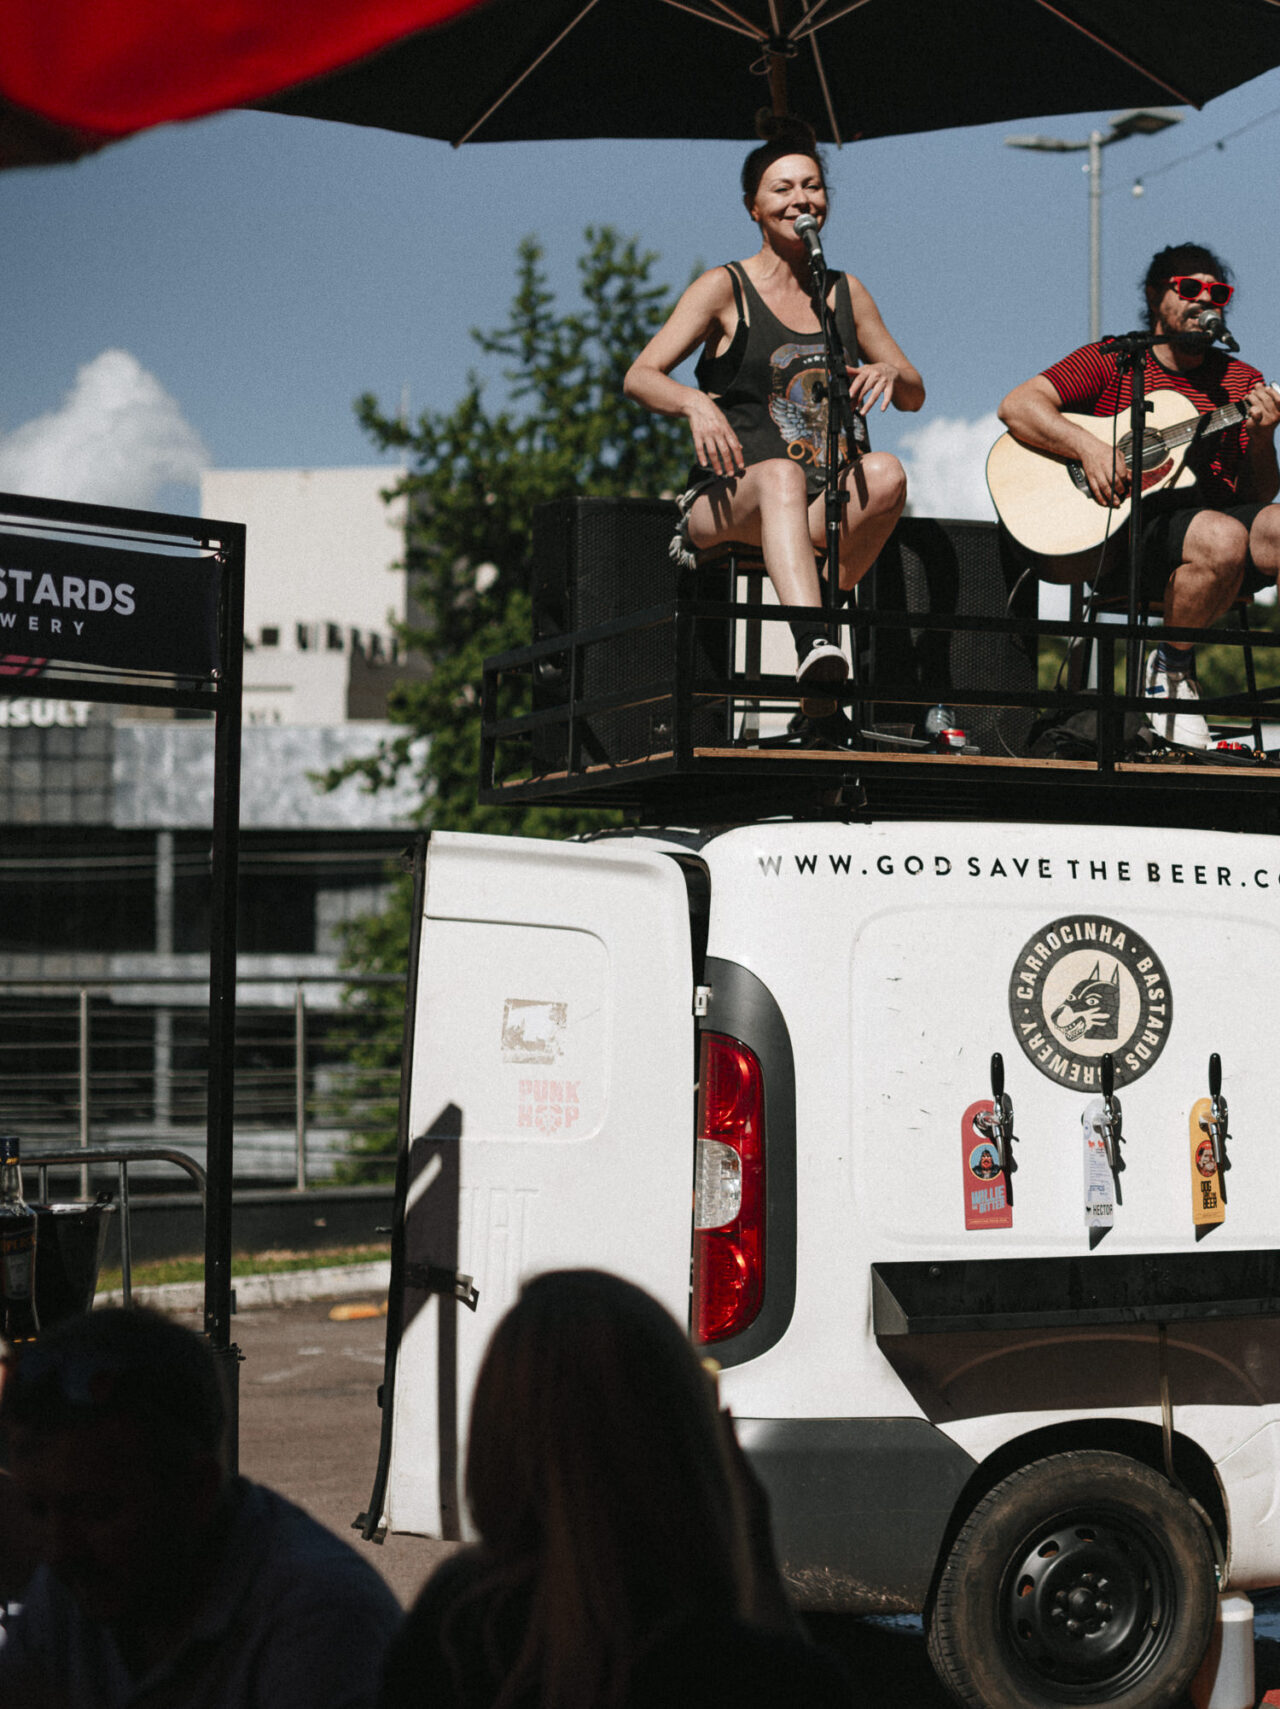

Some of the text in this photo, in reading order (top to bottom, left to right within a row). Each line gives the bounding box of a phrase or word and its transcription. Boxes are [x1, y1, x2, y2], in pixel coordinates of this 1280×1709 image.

[1016, 921, 1166, 1085] CARROCINHA BASTARDS REWERY
[518, 1080, 581, 1103] PUNK
